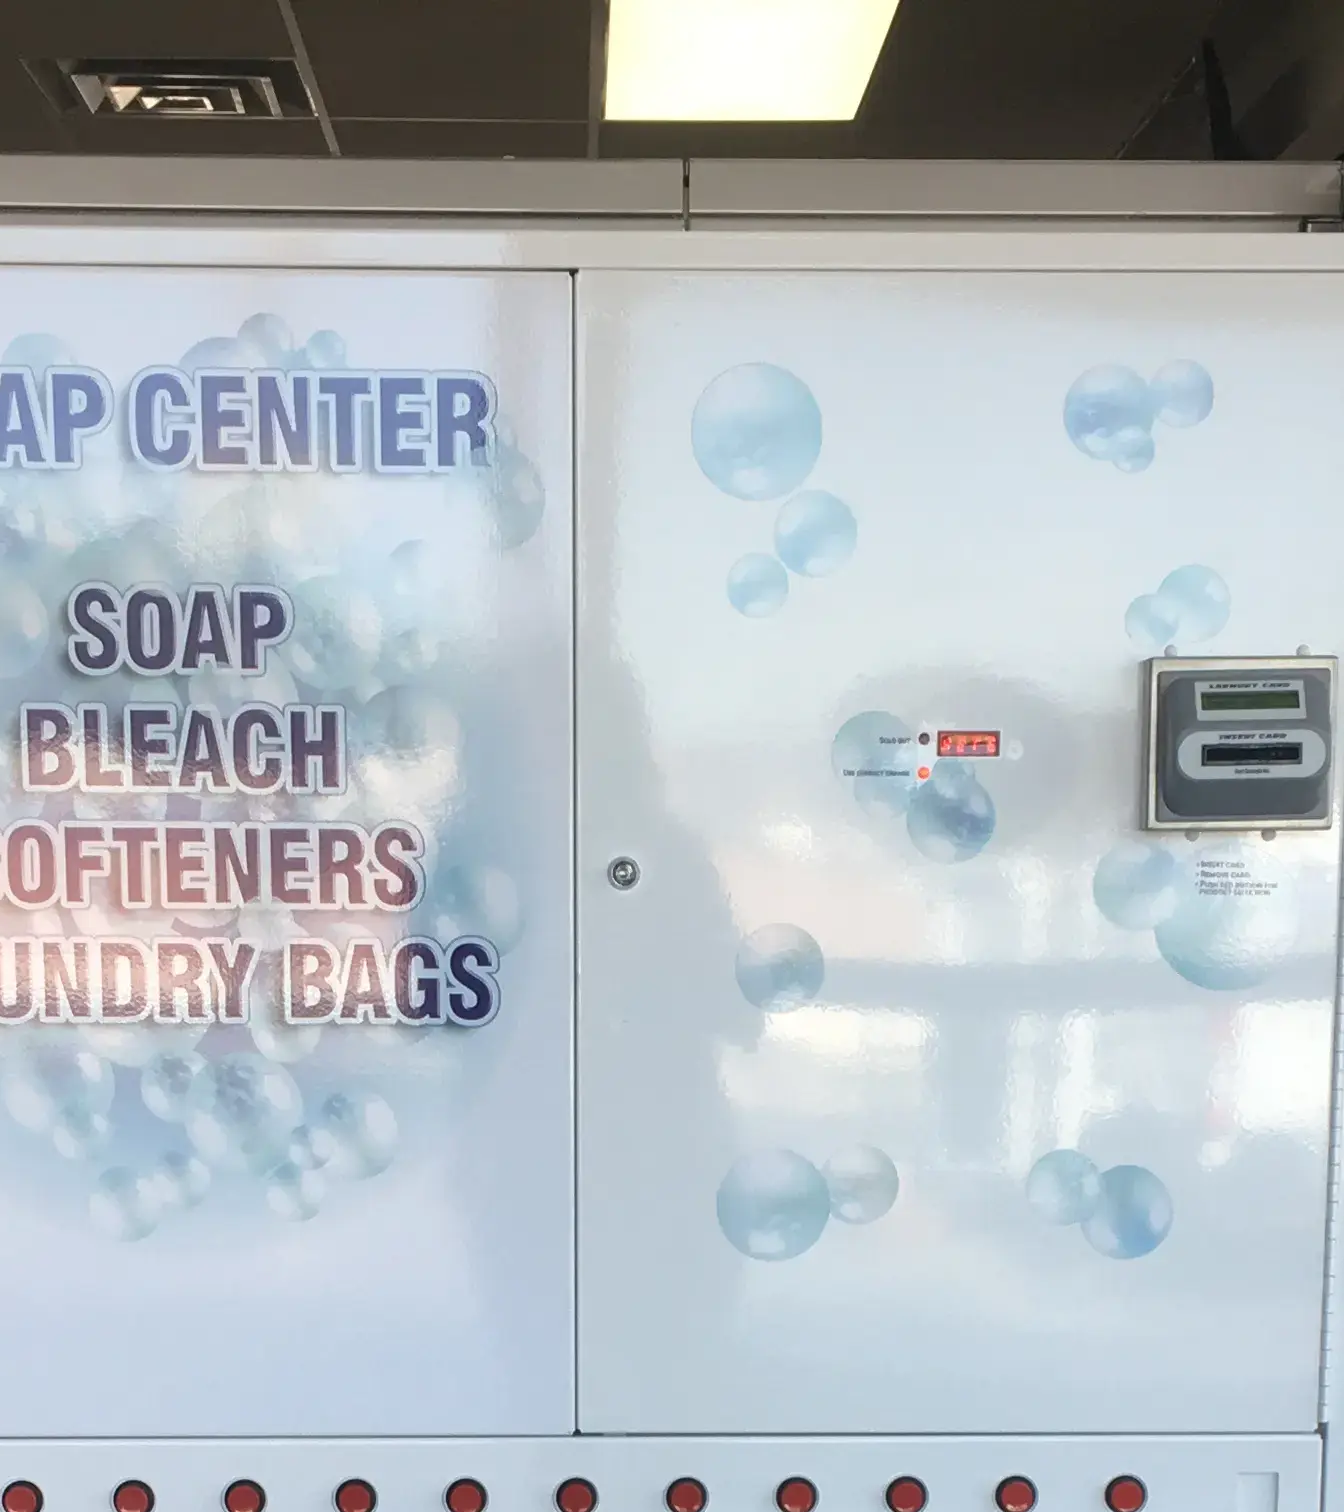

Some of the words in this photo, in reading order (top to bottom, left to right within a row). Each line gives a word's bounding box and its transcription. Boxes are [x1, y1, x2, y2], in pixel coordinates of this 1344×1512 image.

[130, 367, 494, 470] CENTER
[69, 583, 290, 674] SOAP
[22, 704, 345, 792] BLEACH
[285, 939, 499, 1025] BAGS
